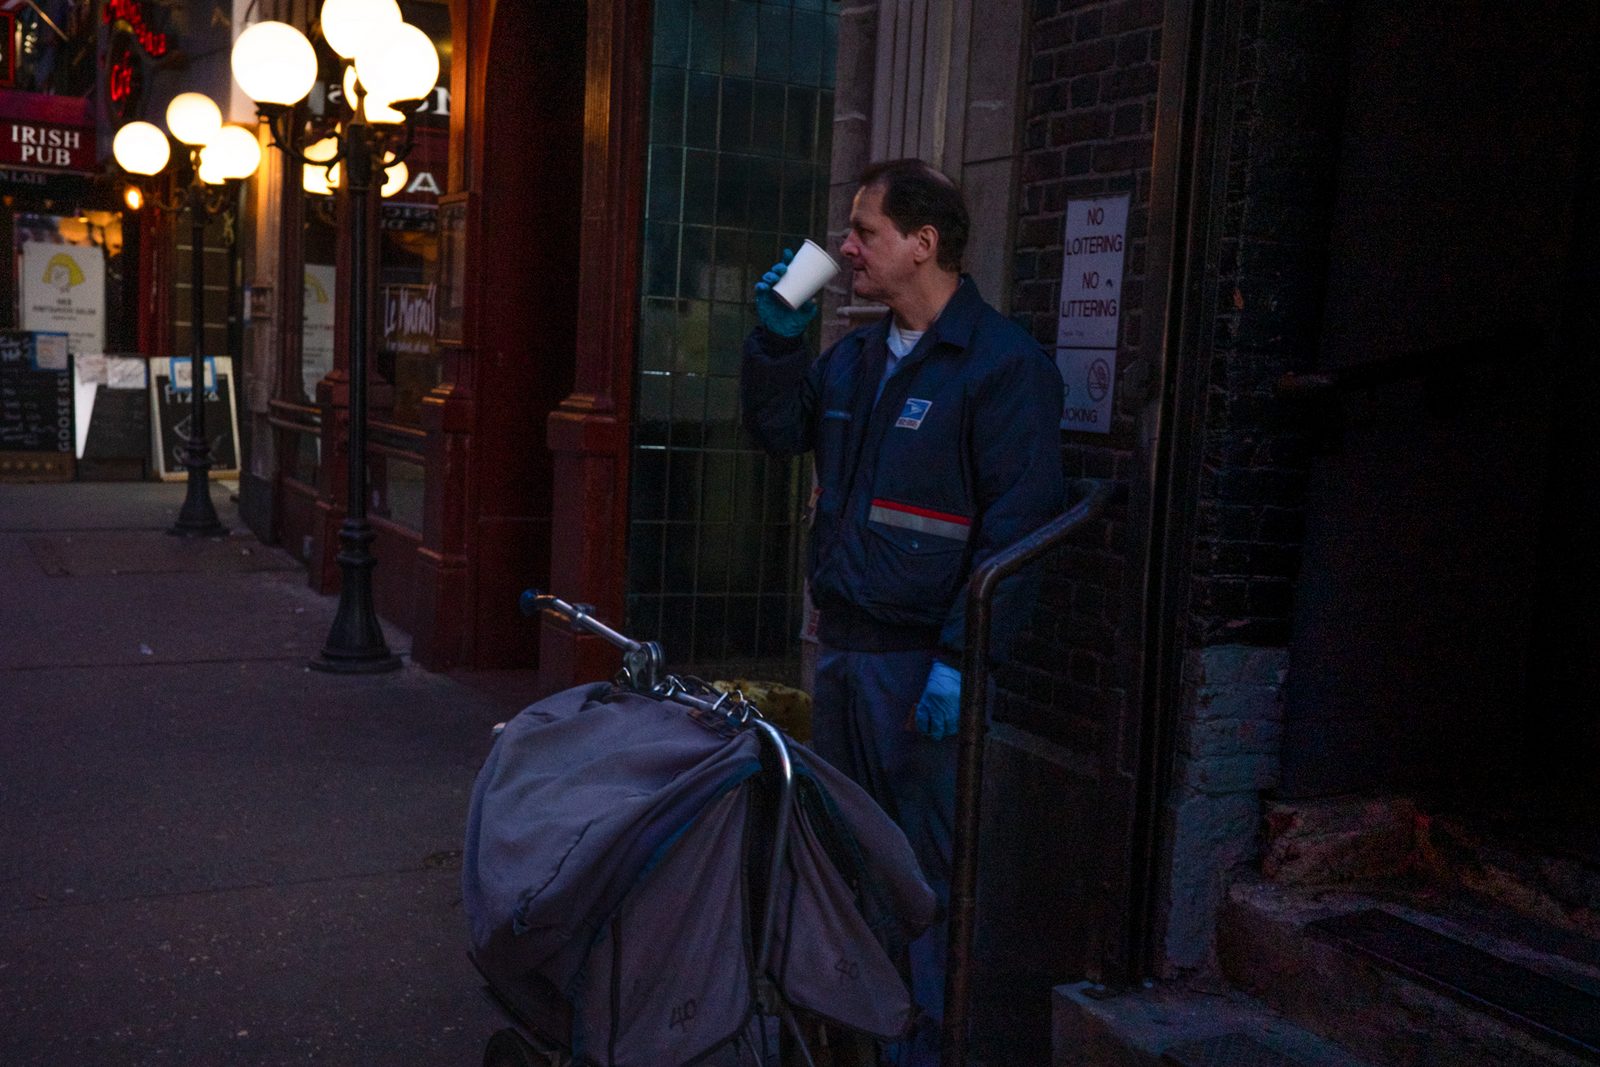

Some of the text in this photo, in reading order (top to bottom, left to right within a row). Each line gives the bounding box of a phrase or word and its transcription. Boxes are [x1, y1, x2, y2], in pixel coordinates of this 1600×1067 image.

[12, 125, 80, 149] IRISH
[21, 144, 71, 166] PUB
[1086, 208, 1105, 226] NO
[1066, 234, 1123, 256] LOITERING
[1082, 271, 1100, 289] NO
[1061, 299, 1118, 318] LITTERING
[57, 397, 70, 452] GOOSE
[1061, 408, 1098, 424] MOKING
[669, 998, 698, 1032] 40
